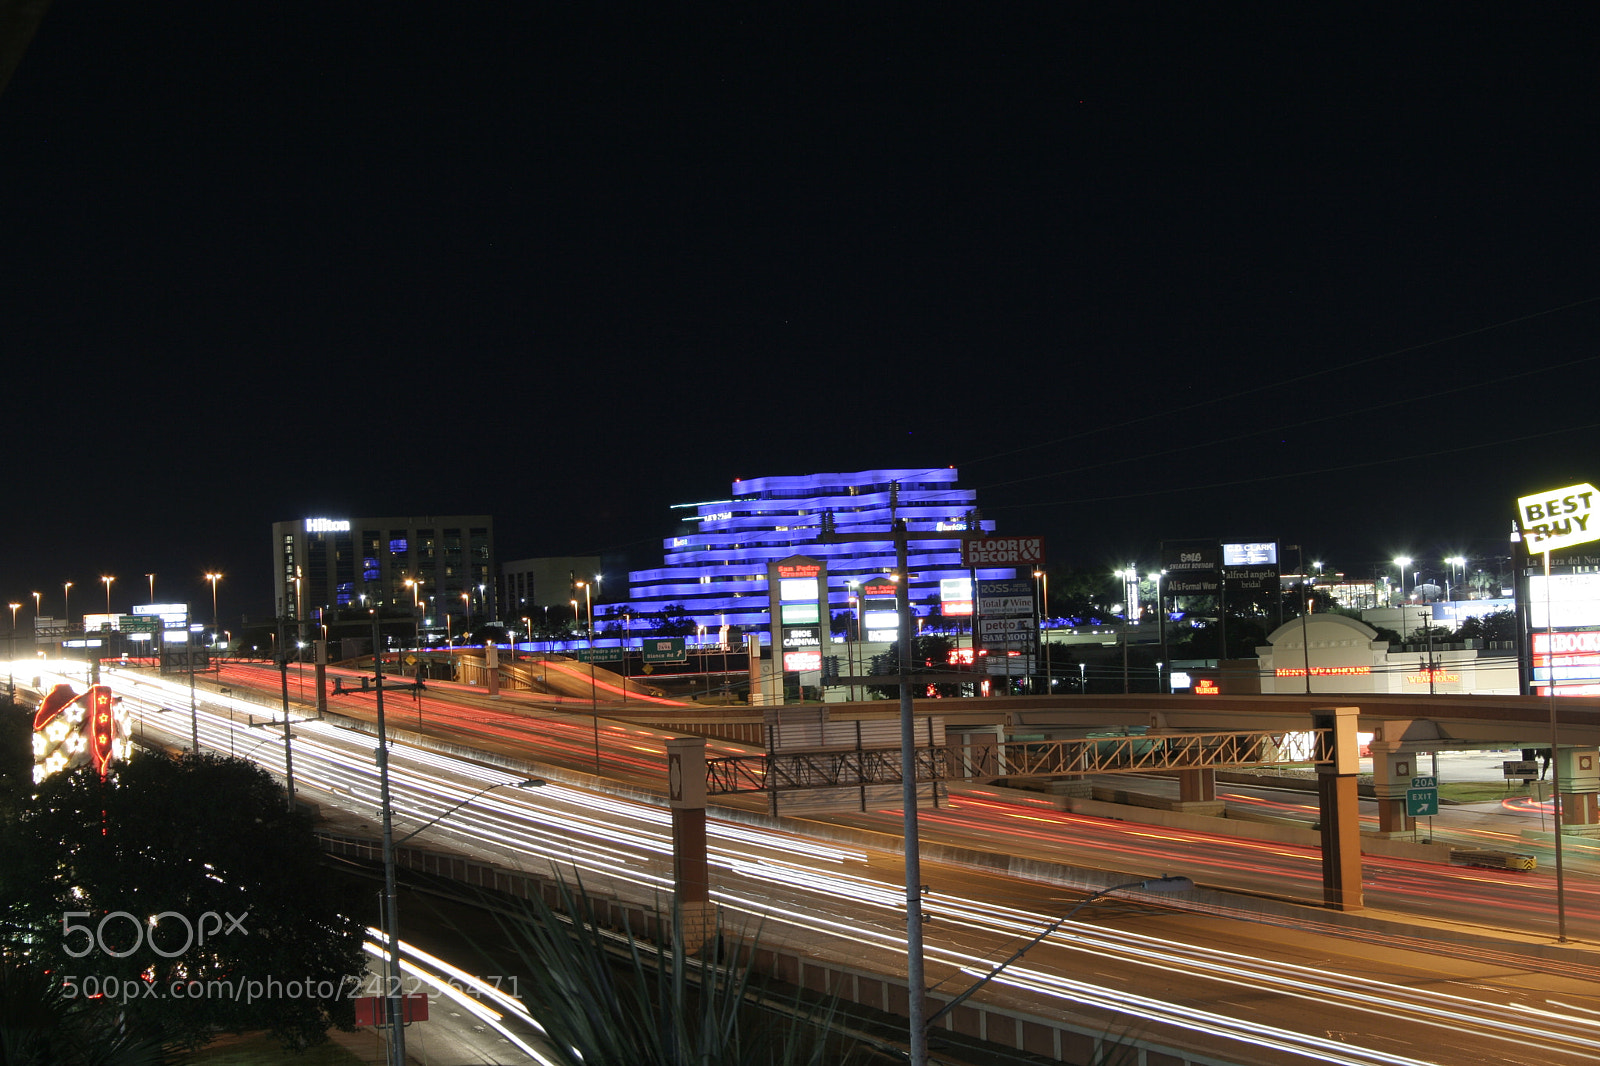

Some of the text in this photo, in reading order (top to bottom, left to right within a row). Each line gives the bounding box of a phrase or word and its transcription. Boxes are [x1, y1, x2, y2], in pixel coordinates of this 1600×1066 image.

[1525, 491, 1593, 522] BEST
[306, 518, 350, 531] Hilton
[1532, 514, 1590, 542] BUY
[969, 540, 1018, 551] FLOOR
[969, 551, 1018, 562] DECOR
[1568, 556, 1580, 565] del
[795, 564, 821, 572] Pedro
[1250, 570, 1276, 580] angelo
[981, 584, 1009, 593] ROSS
[1202, 582, 1217, 590] Wear
[1241, 580, 1262, 589] bridal
[982, 598, 1032, 608] Total Wine
[986, 621, 1015, 631] petco
[790, 630, 812, 638] SHOE
[982, 634, 1003, 642] SAM
[783, 638, 820, 646] CARNIVAL
[1414, 779, 1434, 787] 20A
